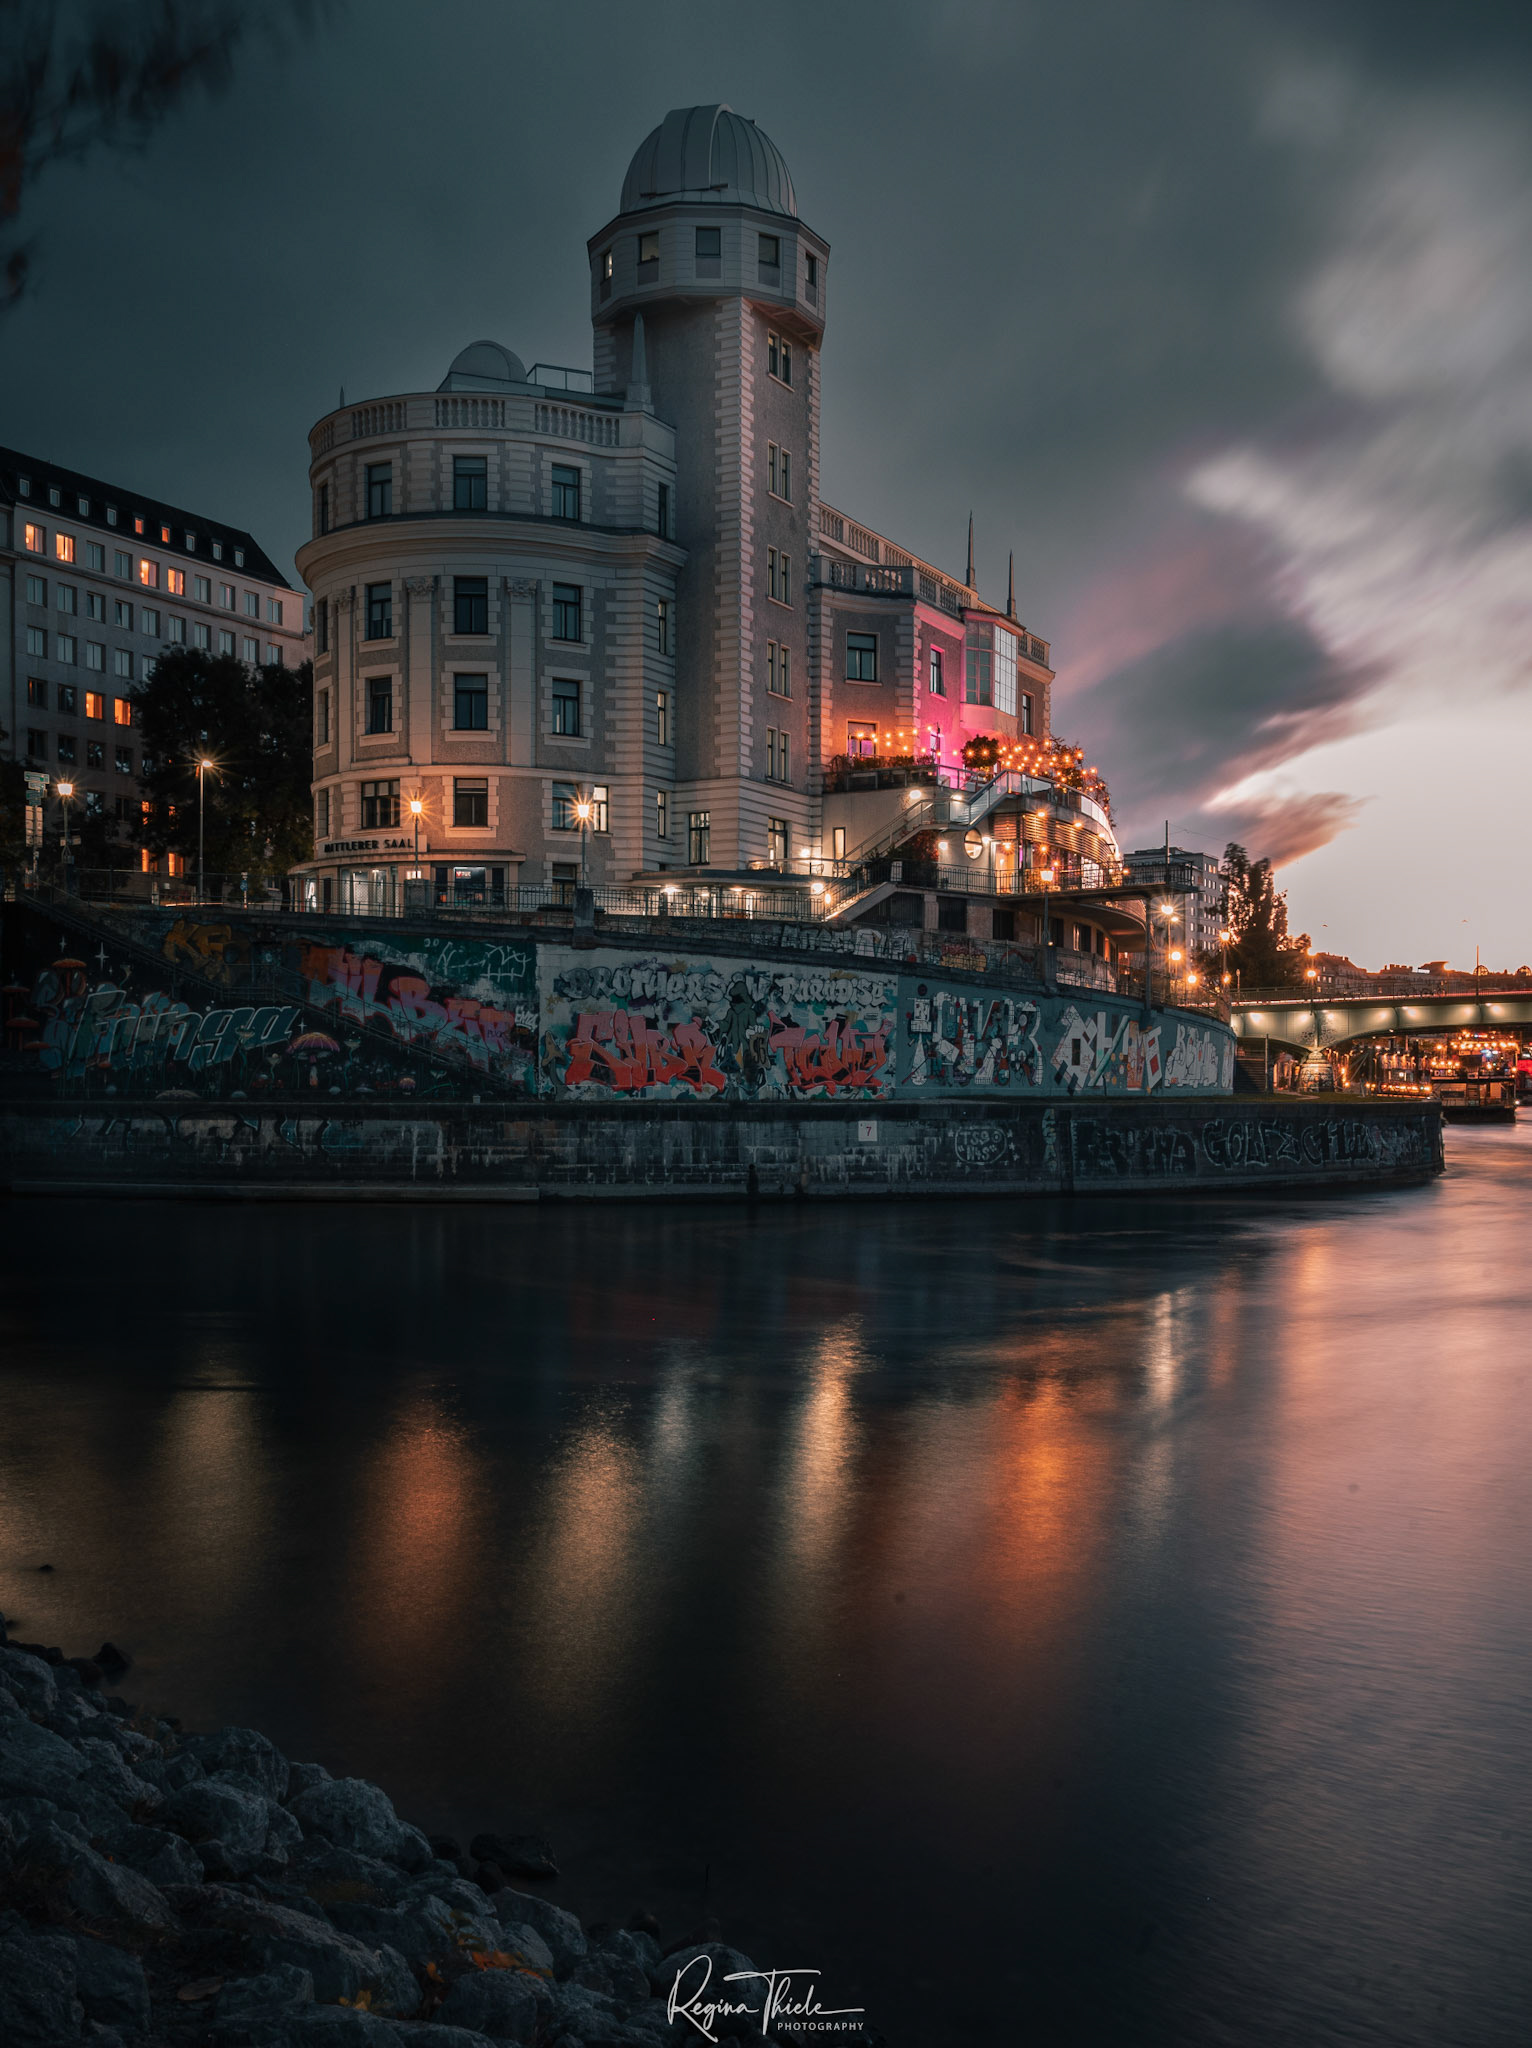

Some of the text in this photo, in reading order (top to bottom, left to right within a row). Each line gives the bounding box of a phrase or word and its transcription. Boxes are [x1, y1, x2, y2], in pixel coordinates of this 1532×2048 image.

[324, 838, 413, 853] MITTLERER SAAL
[866, 1126, 872, 1136] 7
